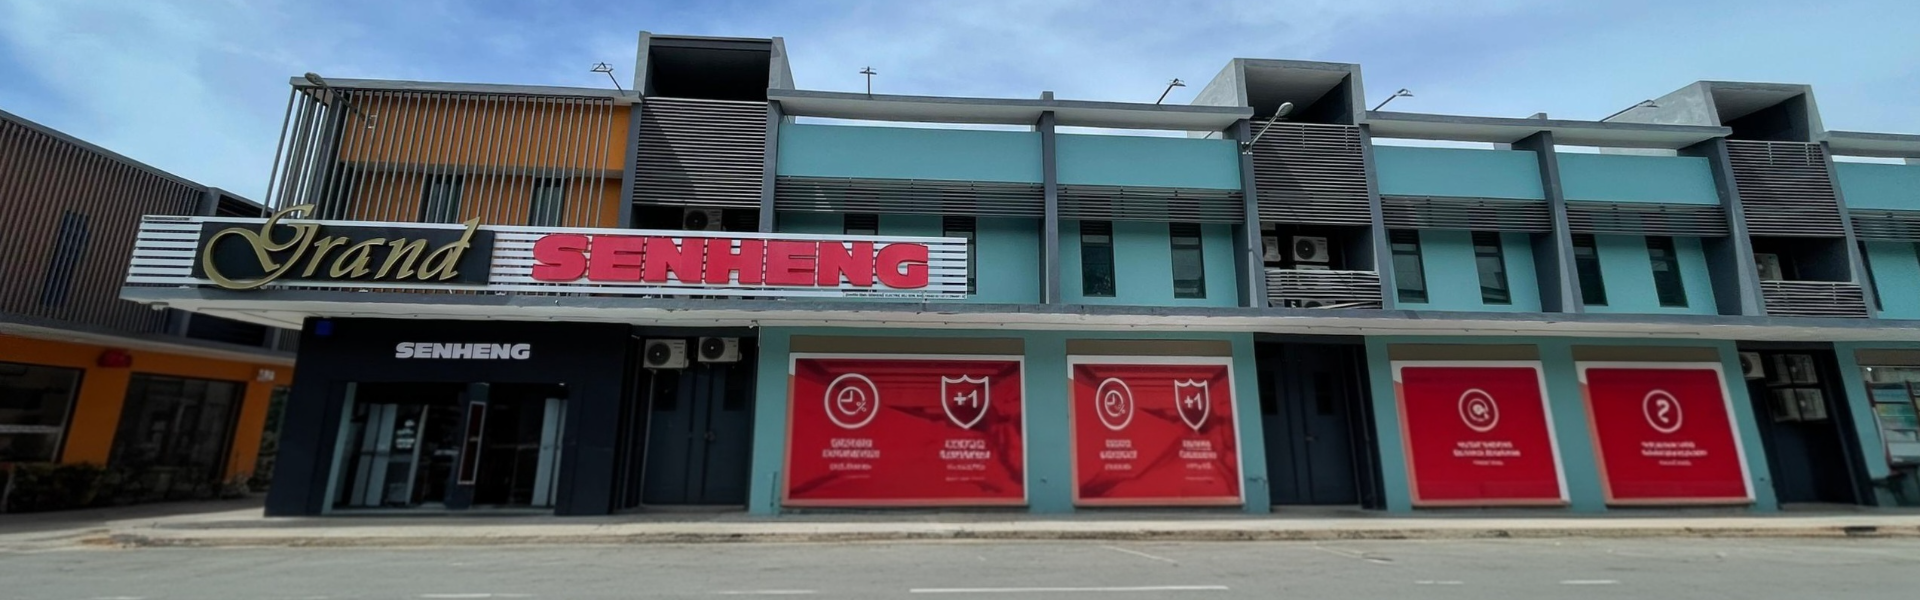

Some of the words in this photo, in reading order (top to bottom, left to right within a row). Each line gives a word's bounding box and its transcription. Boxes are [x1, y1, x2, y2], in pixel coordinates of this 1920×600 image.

[202, 203, 481, 290] Grand
[531, 233, 929, 289] SENHENG
[395, 342, 531, 360] SENHENG
[953, 389, 978, 409] +1
[1184, 392, 1203, 411] +1
